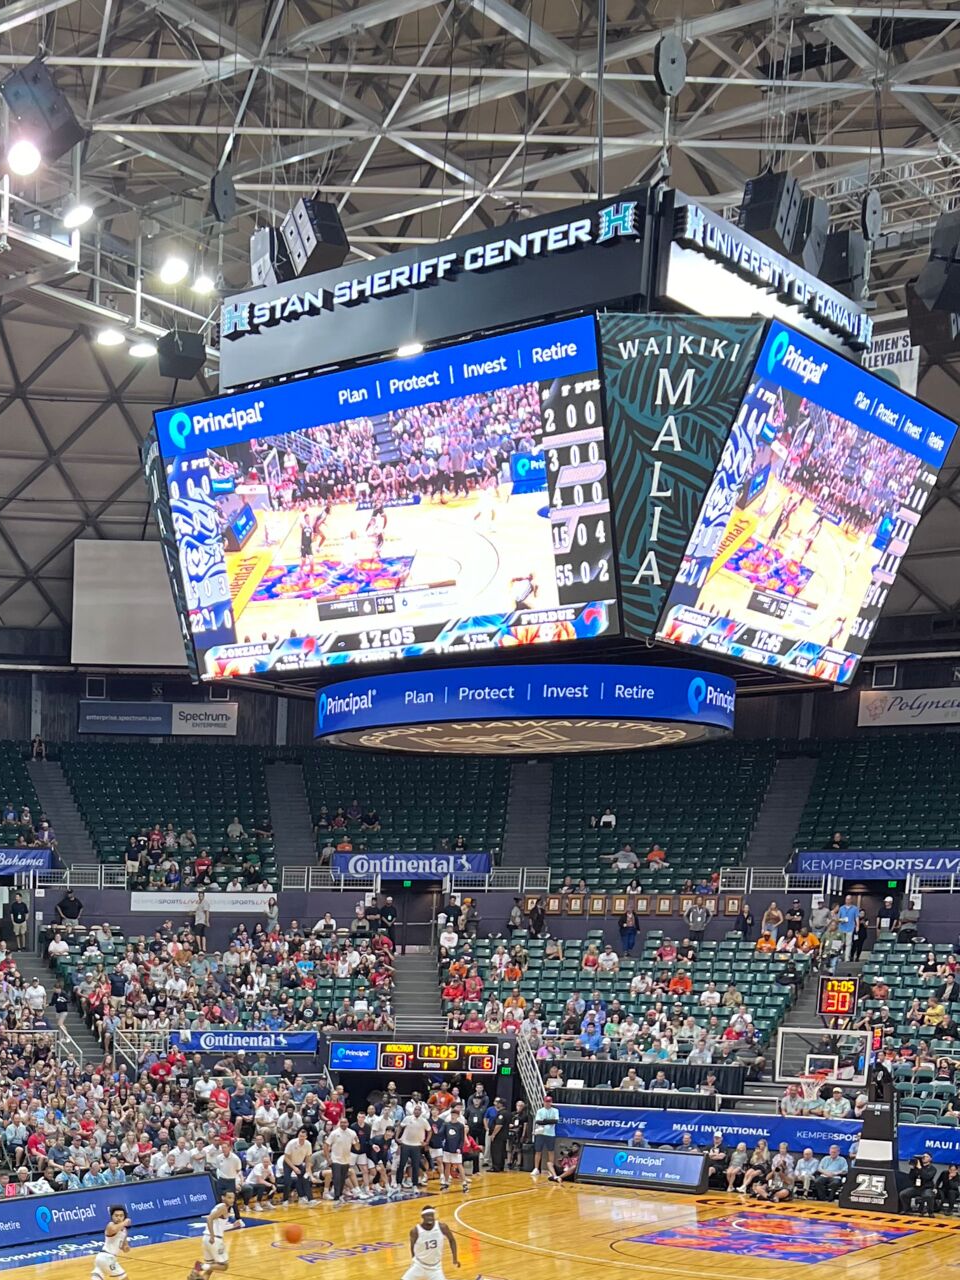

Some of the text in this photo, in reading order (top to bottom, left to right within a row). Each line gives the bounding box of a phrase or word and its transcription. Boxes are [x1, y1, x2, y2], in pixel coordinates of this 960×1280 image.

[253, 288, 324, 324] STAN
[334, 253, 457, 304] SHERIFF
[464, 218, 592, 271] CENTER
[705, 227, 791, 292] UNIVERSITY
[794, 282, 813, 304] OF
[618, 335, 740, 362] WAIKIKI
[338, 341, 577, 406] Plan Protect Invest Retire
[782, 344, 826, 384] Principal
[192, 403, 263, 435] Principal
[544, 401, 596, 432] 2 0 0
[855, 391, 870, 411] Plan
[876, 403, 899, 427] Protect
[903, 418, 922, 440] Invest
[550, 449, 559, 472] 3
[570, 445, 580, 467] 0
[589, 441, 599, 464] 0
[632, 368, 695, 585] MALIA
[553, 481, 602, 510] 4 0 0
[553, 520, 606, 549] 15 0 4
[556, 559, 609, 587] 55 0 2
[521, 609, 576, 625] PURDUE
[359, 626, 416, 650] 17:05
[326, 689, 374, 714] Principal
[404, 690, 434, 705] Plan
[458, 685, 515, 700] Protect
[543, 684, 589, 699] Invest
[615, 684, 655, 700] Retire
[178, 711, 228, 723] Spectrum
[348, 855, 455, 877] Continental
[827, 981, 855, 993] 17:05
[827, 992, 850, 1011] 30
[200, 1033, 275, 1049] Continental
[424, 1045, 457, 1058] 17:05
[559, 1117, 647, 1129] EMPERSPORTSLIVE
[673, 1123, 699, 1132] MAUI
[701, 1124, 770, 1136] INVITATIONAL
[925, 1140, 952, 1149] MAUI
[627, 1155, 661, 1167] Principal
[856, 1174, 885, 1192] 25
[0, 1221, 21, 1232] Retire
[52, 1205, 94, 1223] Principal
[131, 1200, 154, 1211] Protect
[162, 1196, 181, 1206] Invest
[190, 1193, 207, 1202] Retire
[424, 1240, 438, 1250] 13
